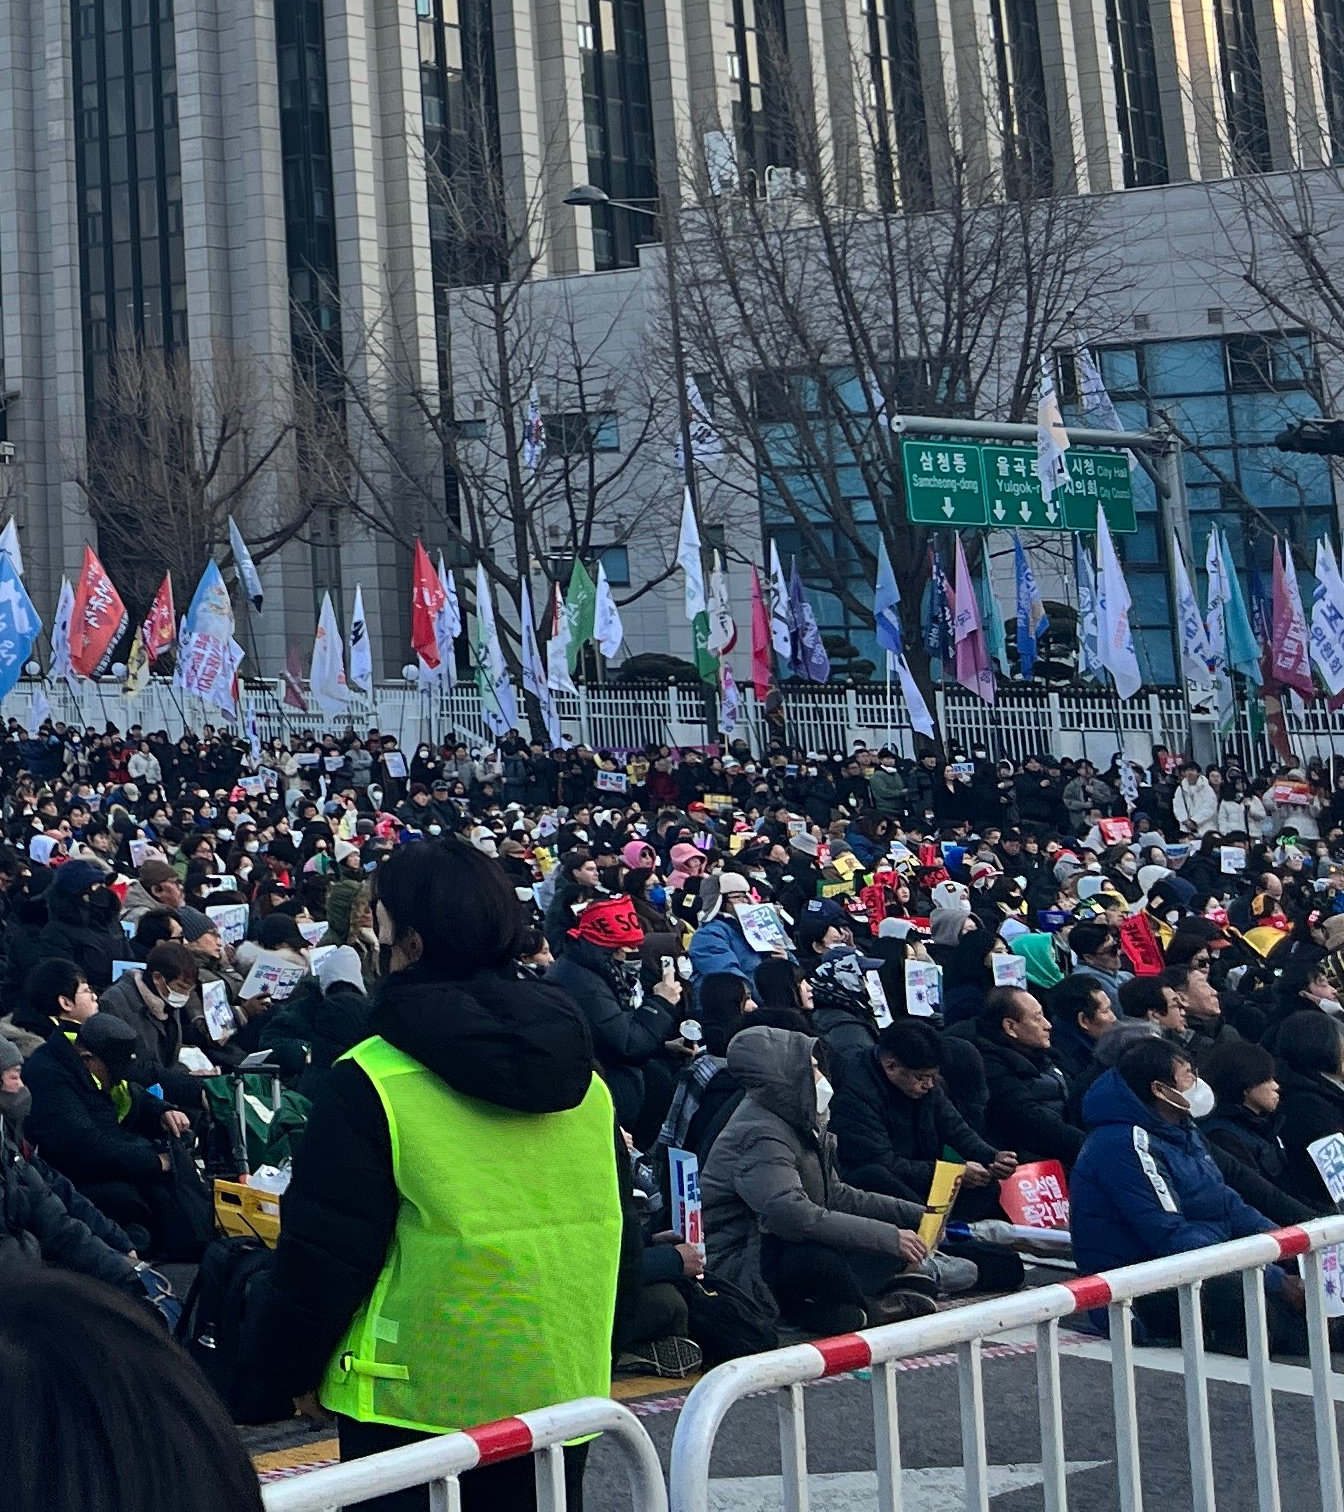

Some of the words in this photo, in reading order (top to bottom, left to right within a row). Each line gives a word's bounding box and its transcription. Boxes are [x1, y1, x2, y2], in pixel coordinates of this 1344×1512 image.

[919, 450, 967, 474] 삼청동
[1072, 458, 1095, 476] 시청
[912, 474, 979, 493] Samcheong-dong
[996, 478, 1042, 496] Yulgok-r
[1064, 479, 1098, 498] 시의회
[1018, 1175, 1062, 1203] 윤석열
